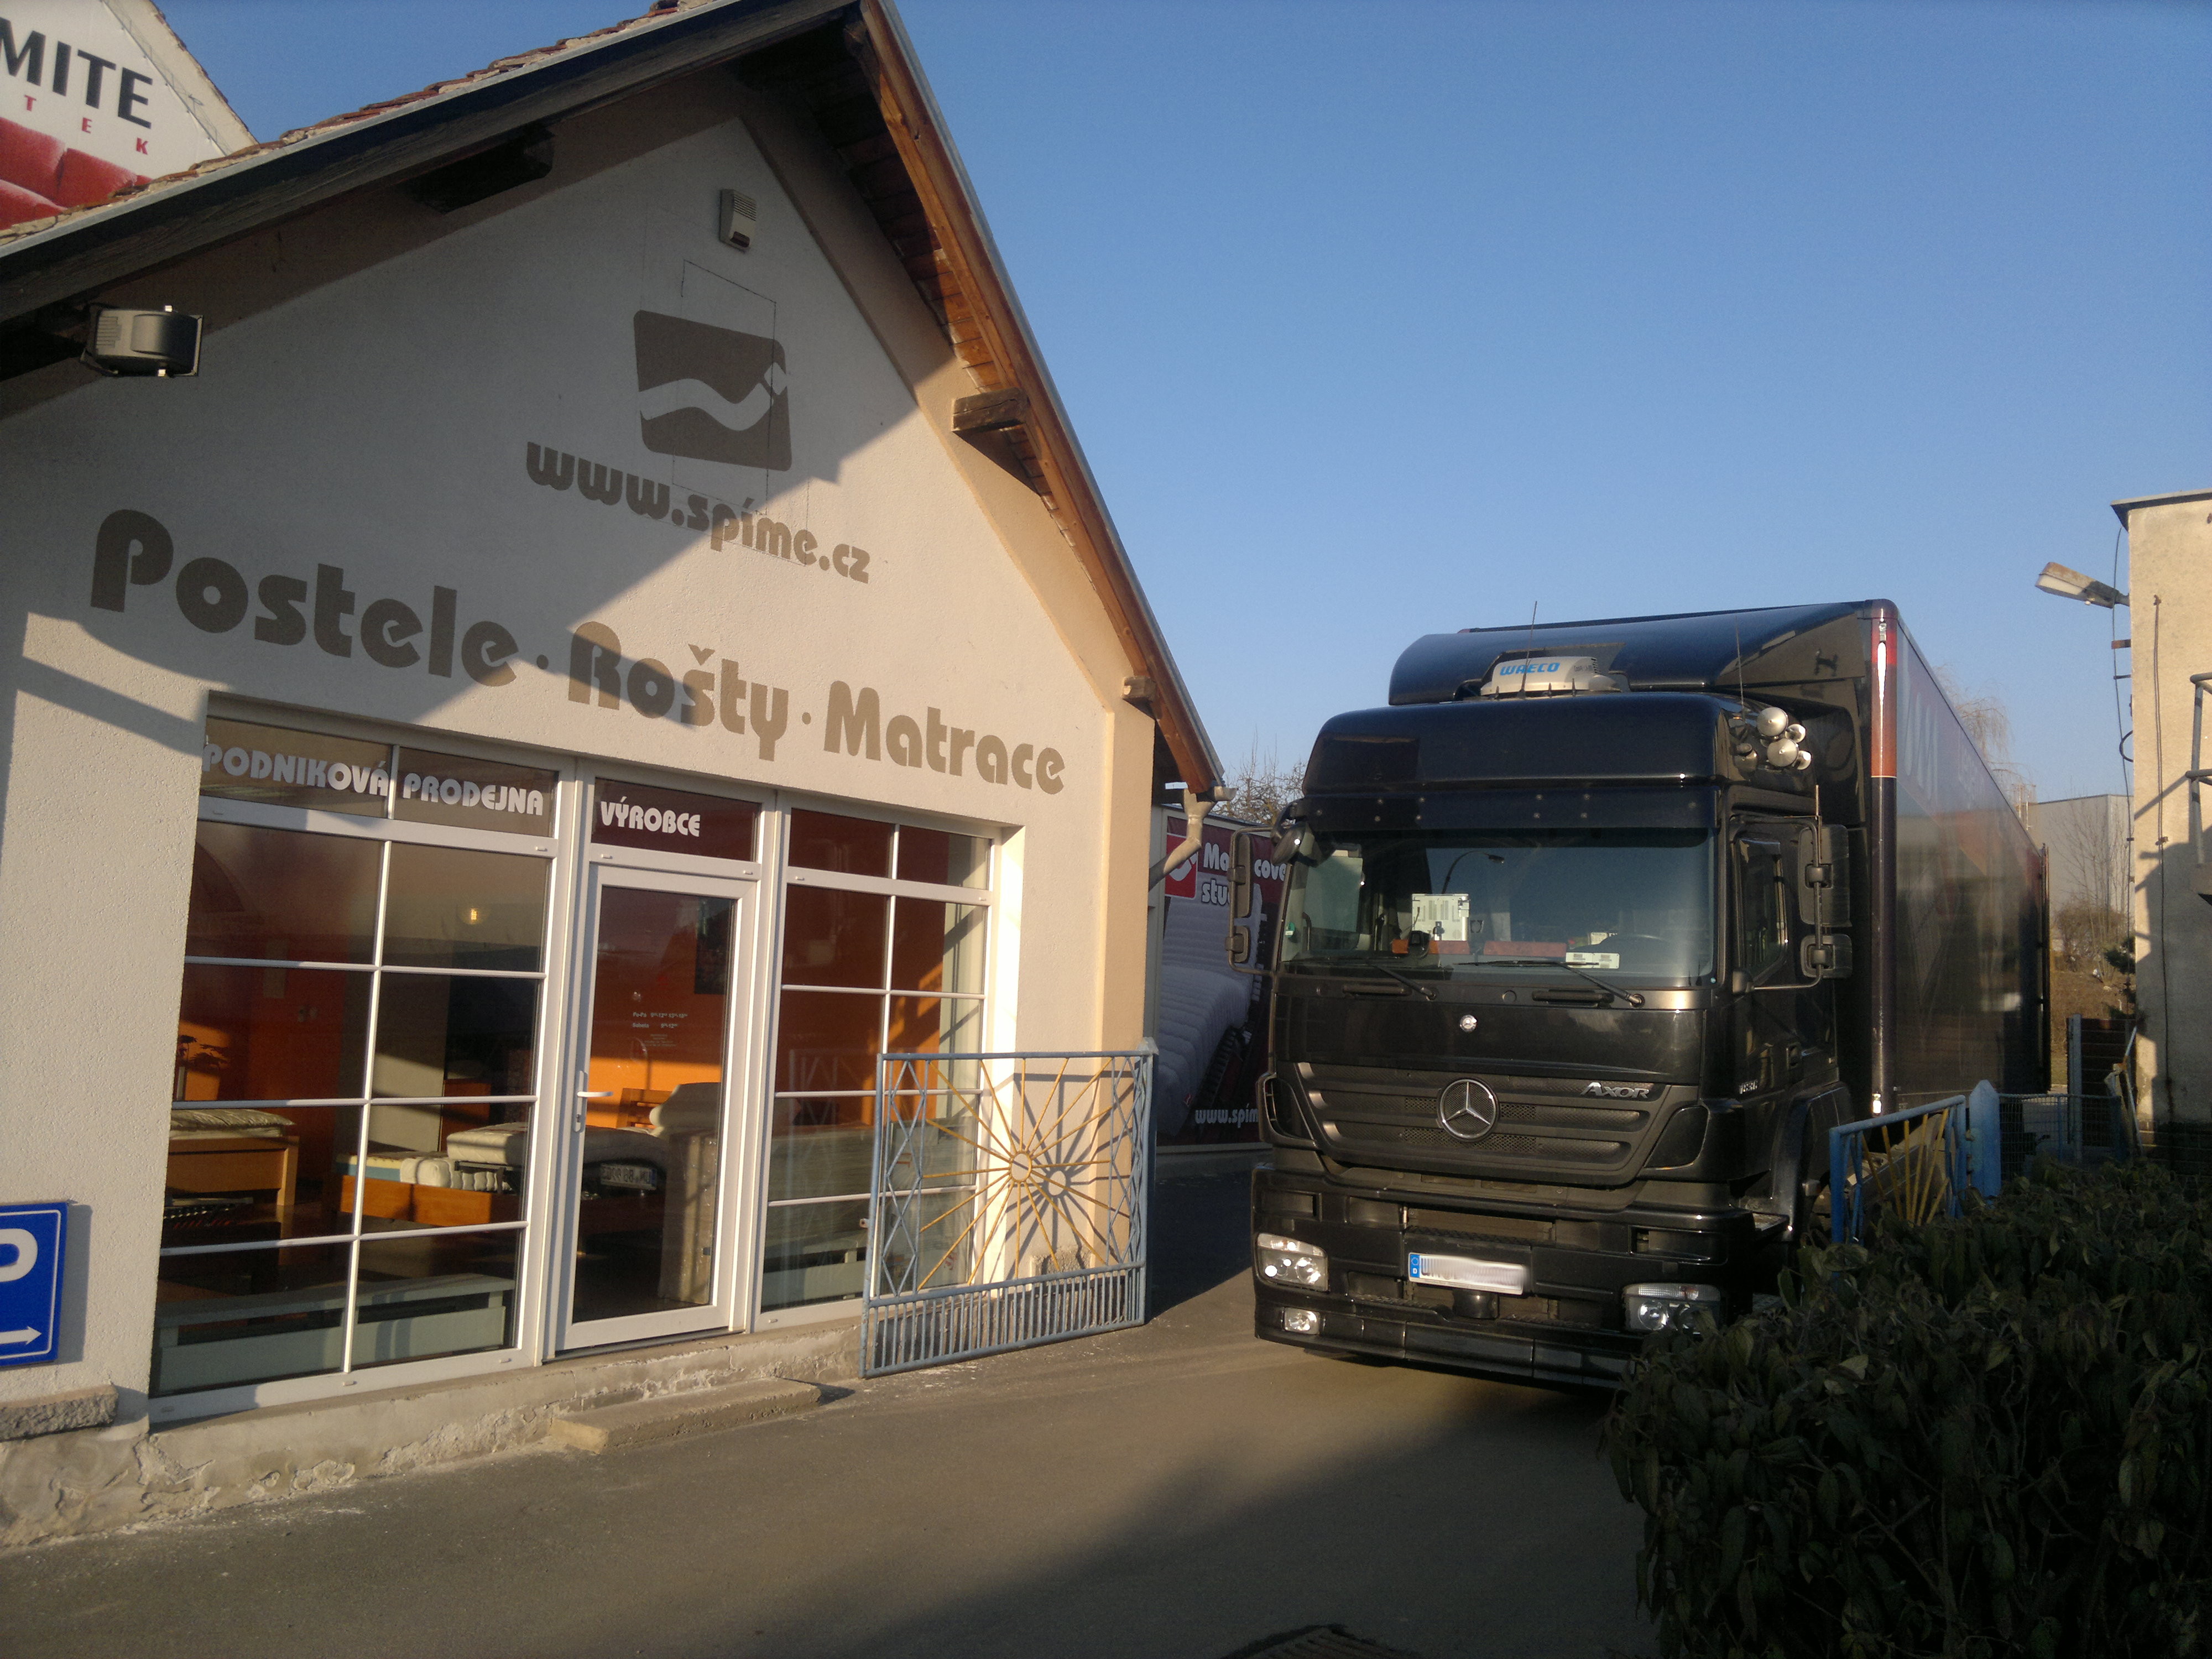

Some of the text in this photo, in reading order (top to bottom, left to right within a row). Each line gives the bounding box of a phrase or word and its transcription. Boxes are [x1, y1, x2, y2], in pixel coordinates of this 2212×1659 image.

[525, 441, 871, 584] www.spíme.cz
[90, 509, 1066, 795] Postele Rošty Matrace
[1499, 662, 1561, 676] WAECO
[201, 743, 544, 816] PODNIKOVÁ PRODEJNA
[601, 796, 700, 837] VÝROBCE
